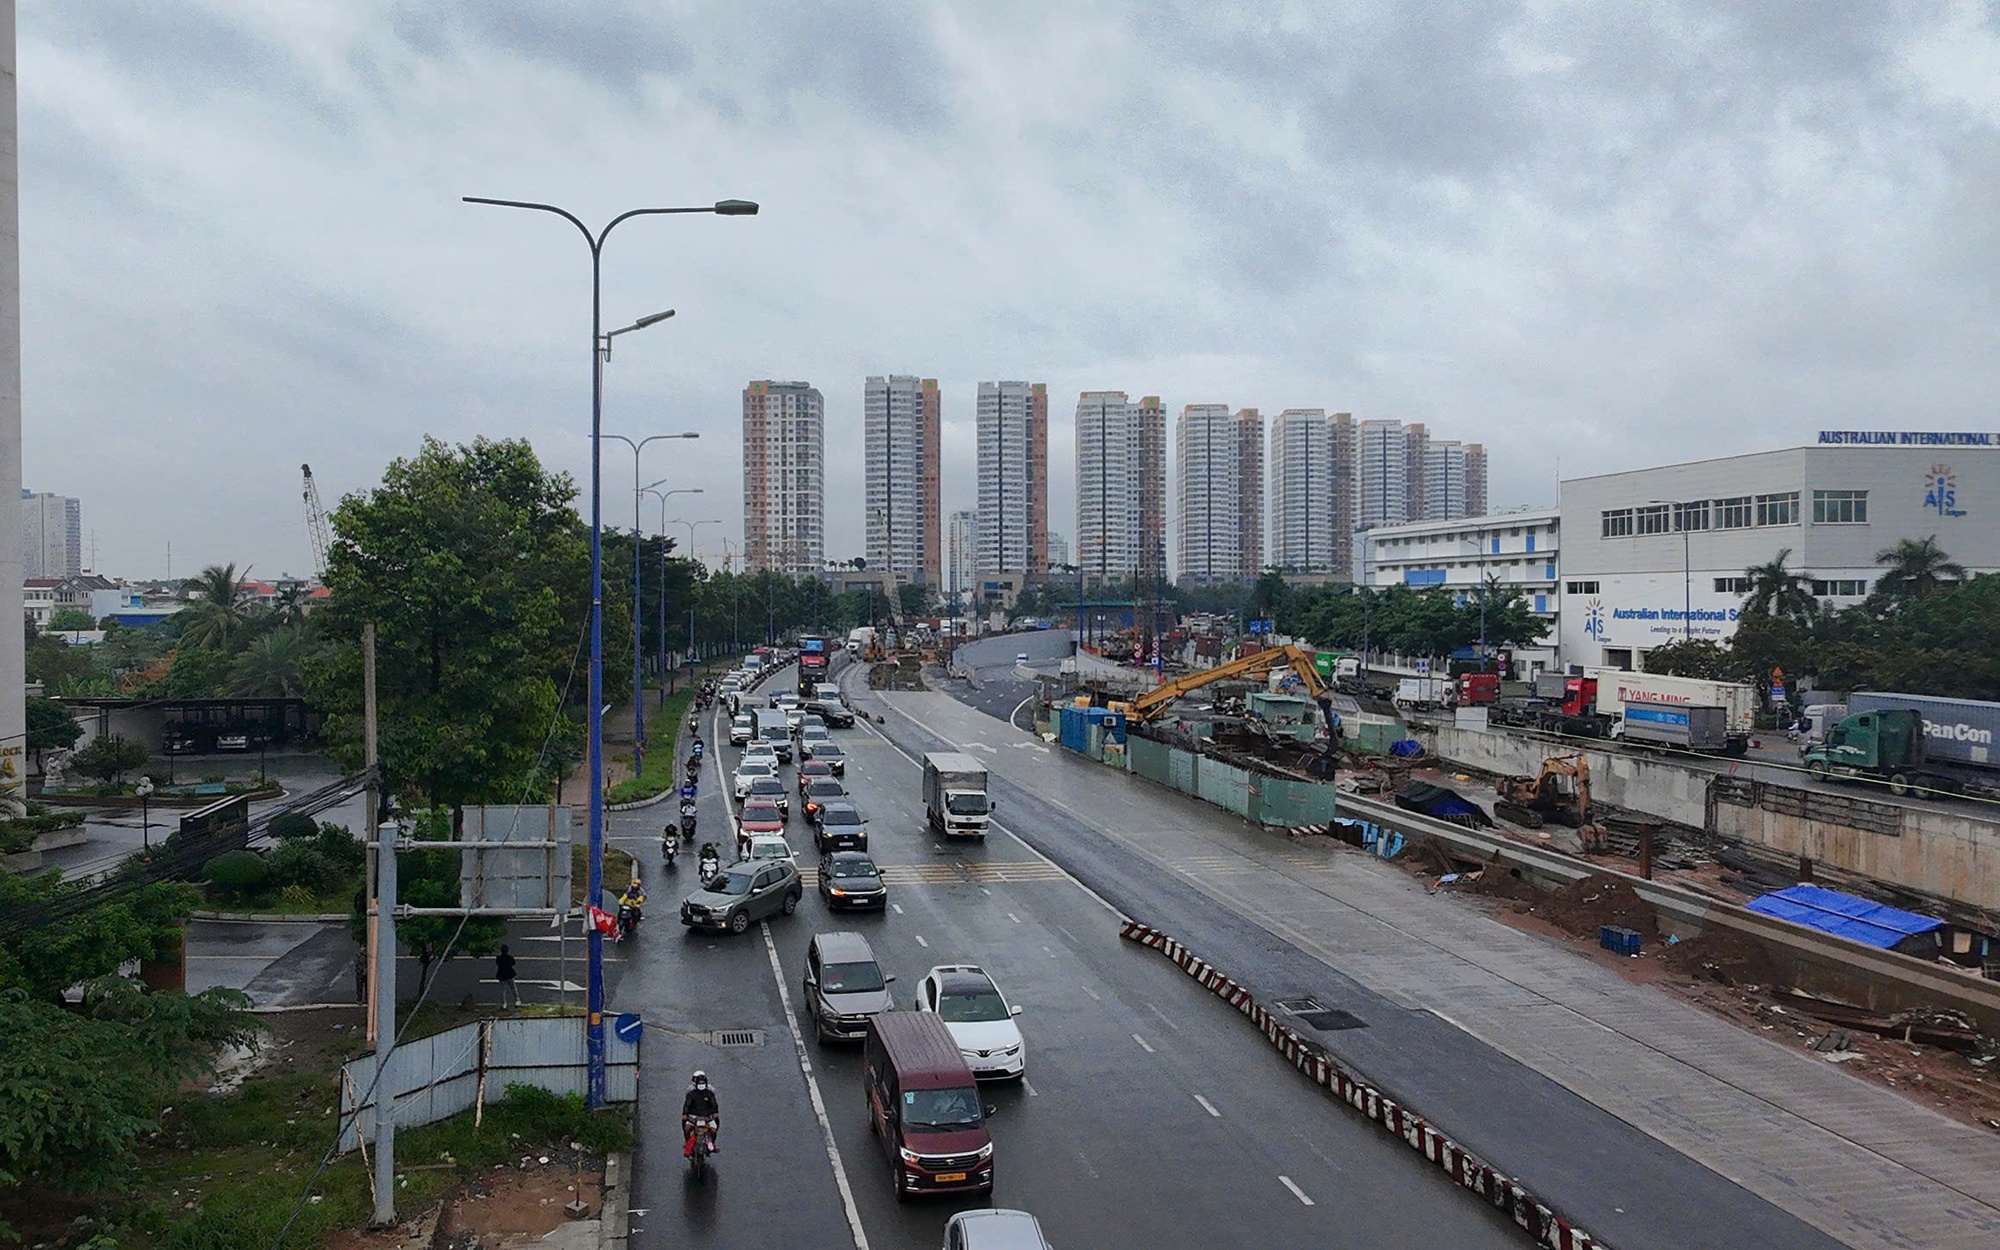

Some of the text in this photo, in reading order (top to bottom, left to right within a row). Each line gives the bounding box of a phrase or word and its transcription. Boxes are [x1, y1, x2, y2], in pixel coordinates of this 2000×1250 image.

[1818, 431, 1896, 444] AUSTRALIAN
[1901, 432, 1992, 445] INTERNATIONAL
[1613, 608, 1659, 620] Australian
[1661, 608, 1726, 621] International
[1650, 625, 1670, 635] Leading
[1702, 627, 1720, 635] Future
[1629, 689, 1658, 701] YANG
[1922, 719, 1992, 744] PanCon
